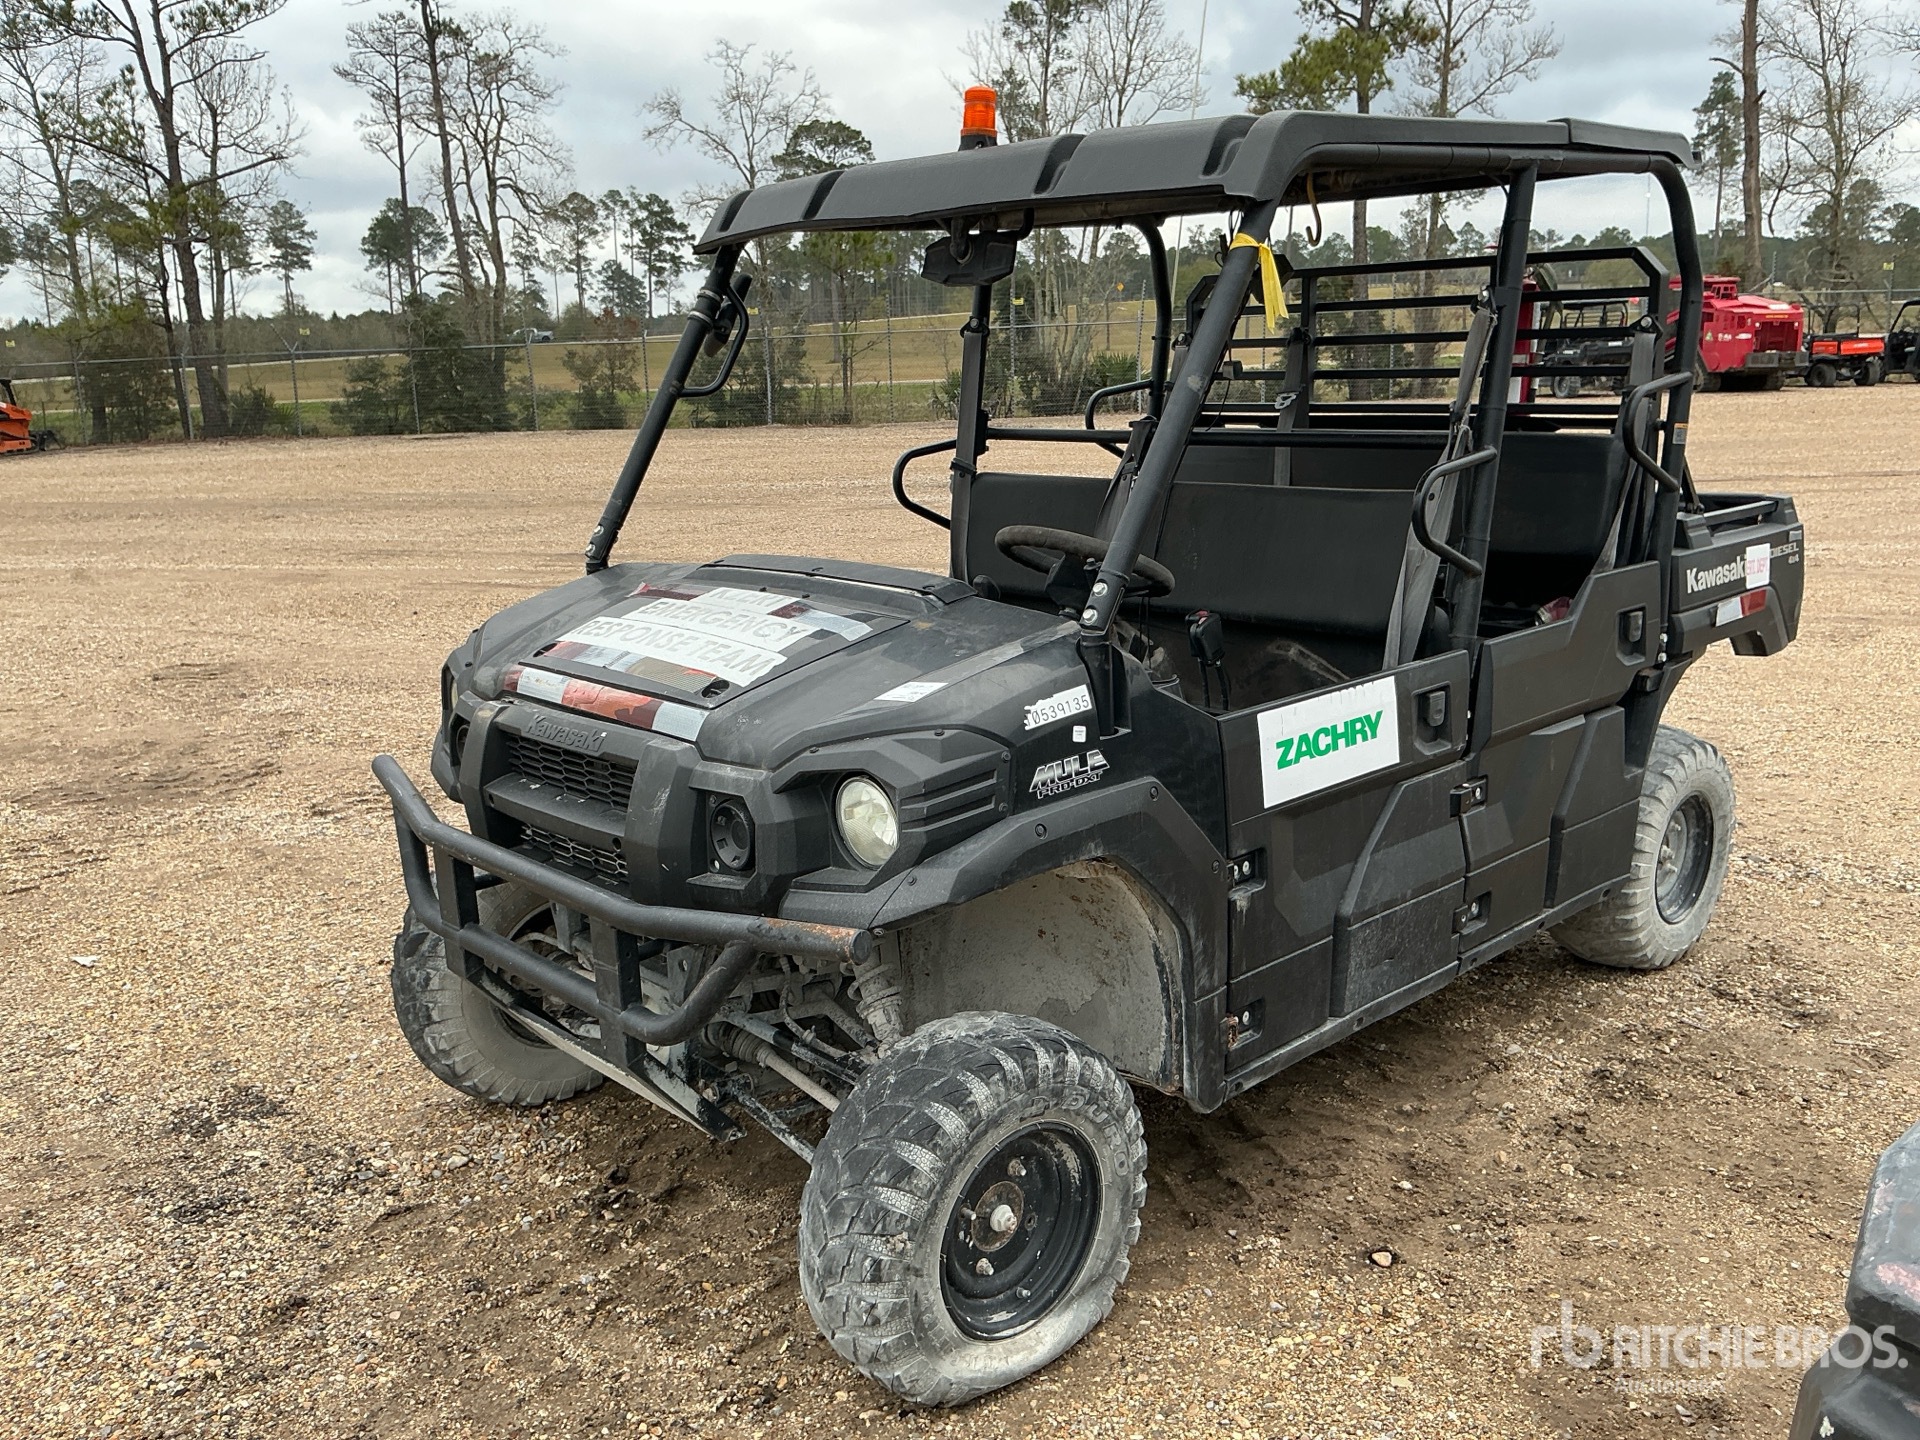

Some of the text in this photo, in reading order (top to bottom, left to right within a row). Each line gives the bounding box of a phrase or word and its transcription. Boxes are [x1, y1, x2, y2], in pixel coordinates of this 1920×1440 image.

[1770, 542, 1799, 559] DIESEL
[1686, 554, 1747, 594] Kawasaki
[639, 601, 807, 642] EMERGENCY
[571, 619, 776, 677] RESPONSE TEAM
[526, 715, 608, 752] Kawasaki
[1275, 709, 1384, 771] ZACHRY
[1028, 749, 1111, 793] MULE
